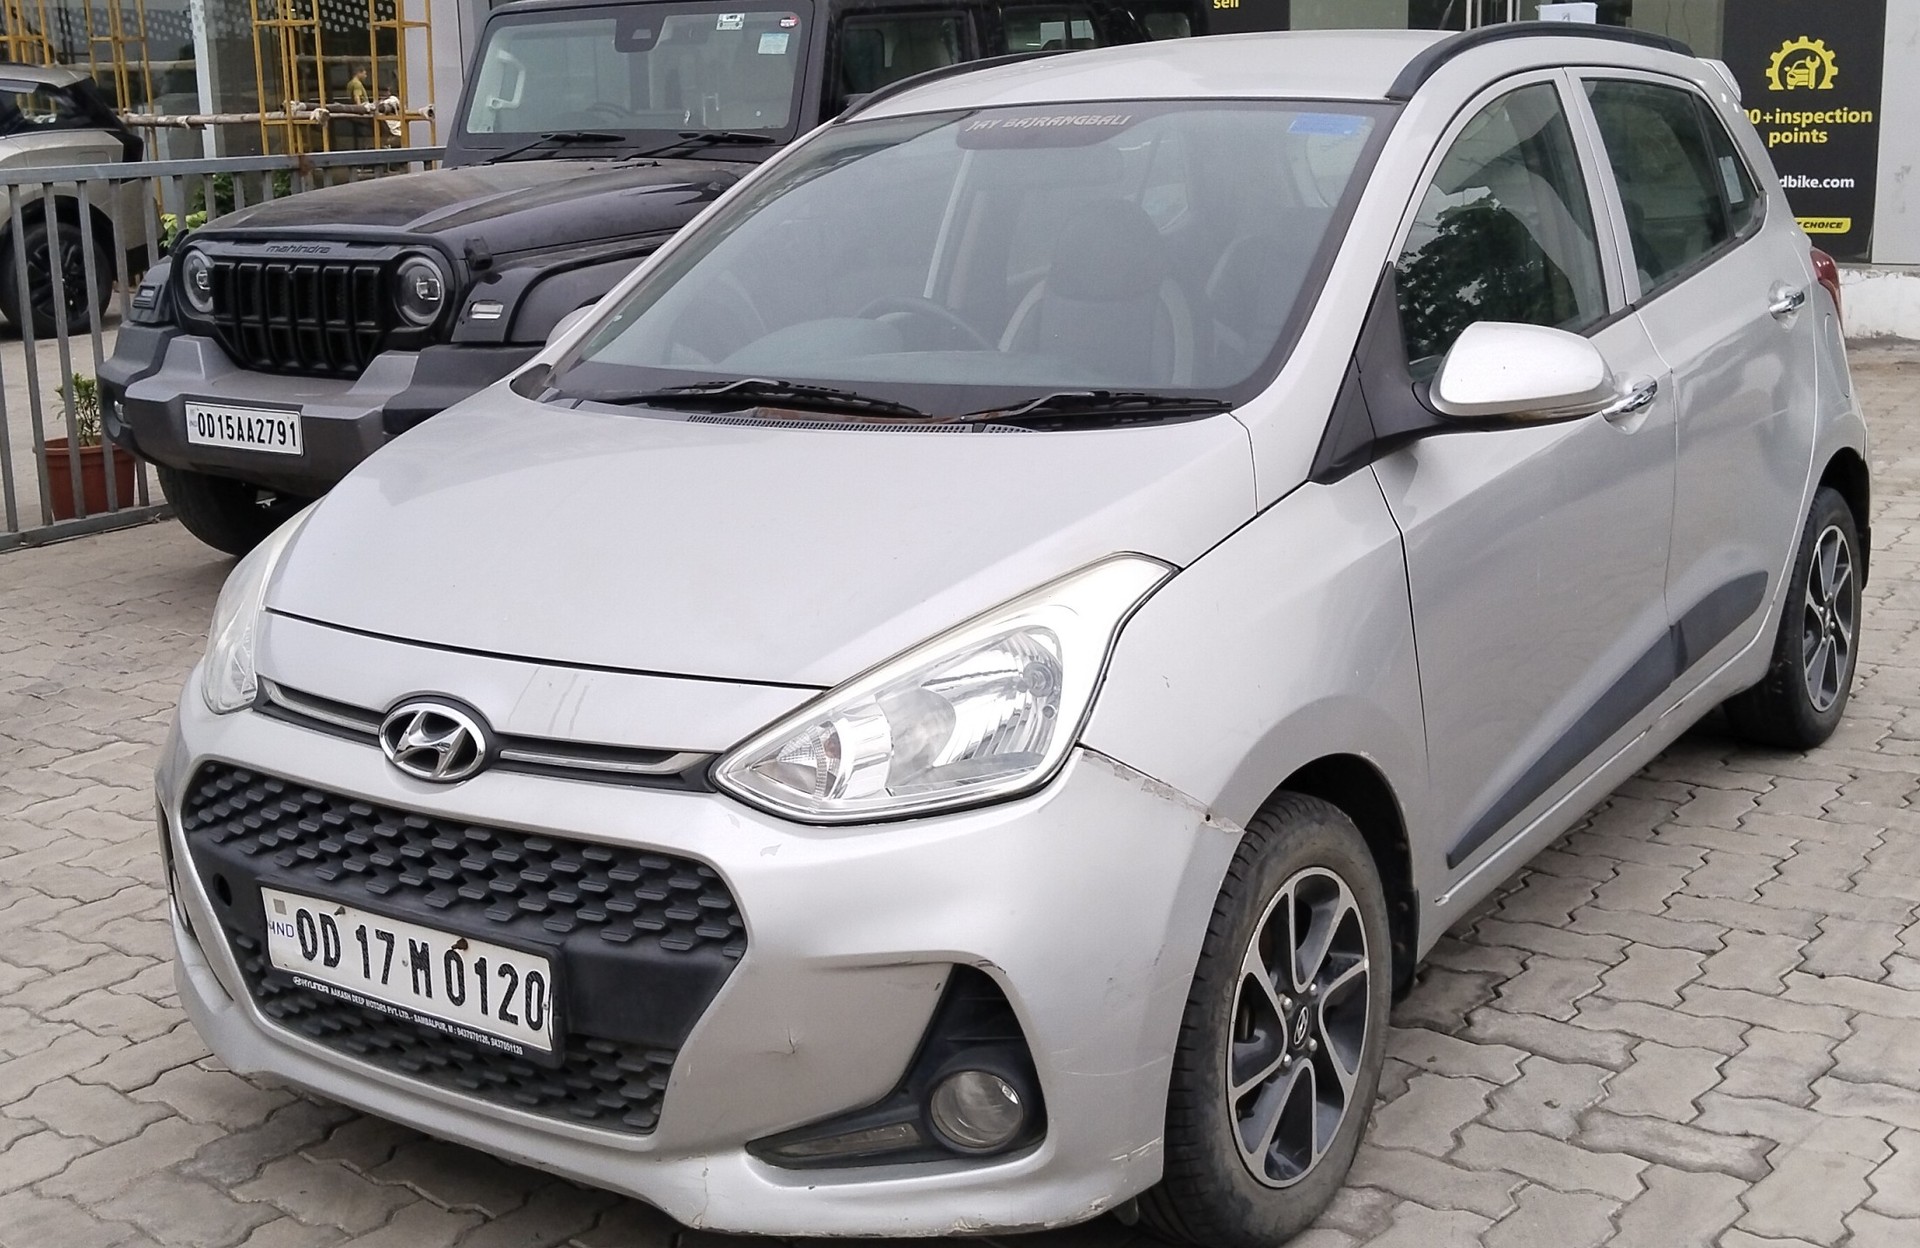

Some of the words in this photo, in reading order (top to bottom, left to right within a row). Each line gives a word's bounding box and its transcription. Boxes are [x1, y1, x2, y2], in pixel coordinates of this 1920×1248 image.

[965, 119, 1002, 132] JAY
[1002, 114, 1133, 129] BAJRANGBALI
[1768, 127, 1828, 148] points
[1803, 221, 1843, 229] CHOICE
[266, 245, 332, 254] mahindra
[198, 412, 297, 447] OD15AA2791
[355, 924, 395, 986] 17
[408, 938, 433, 999] M
[443, 949, 546, 1032] 0120
